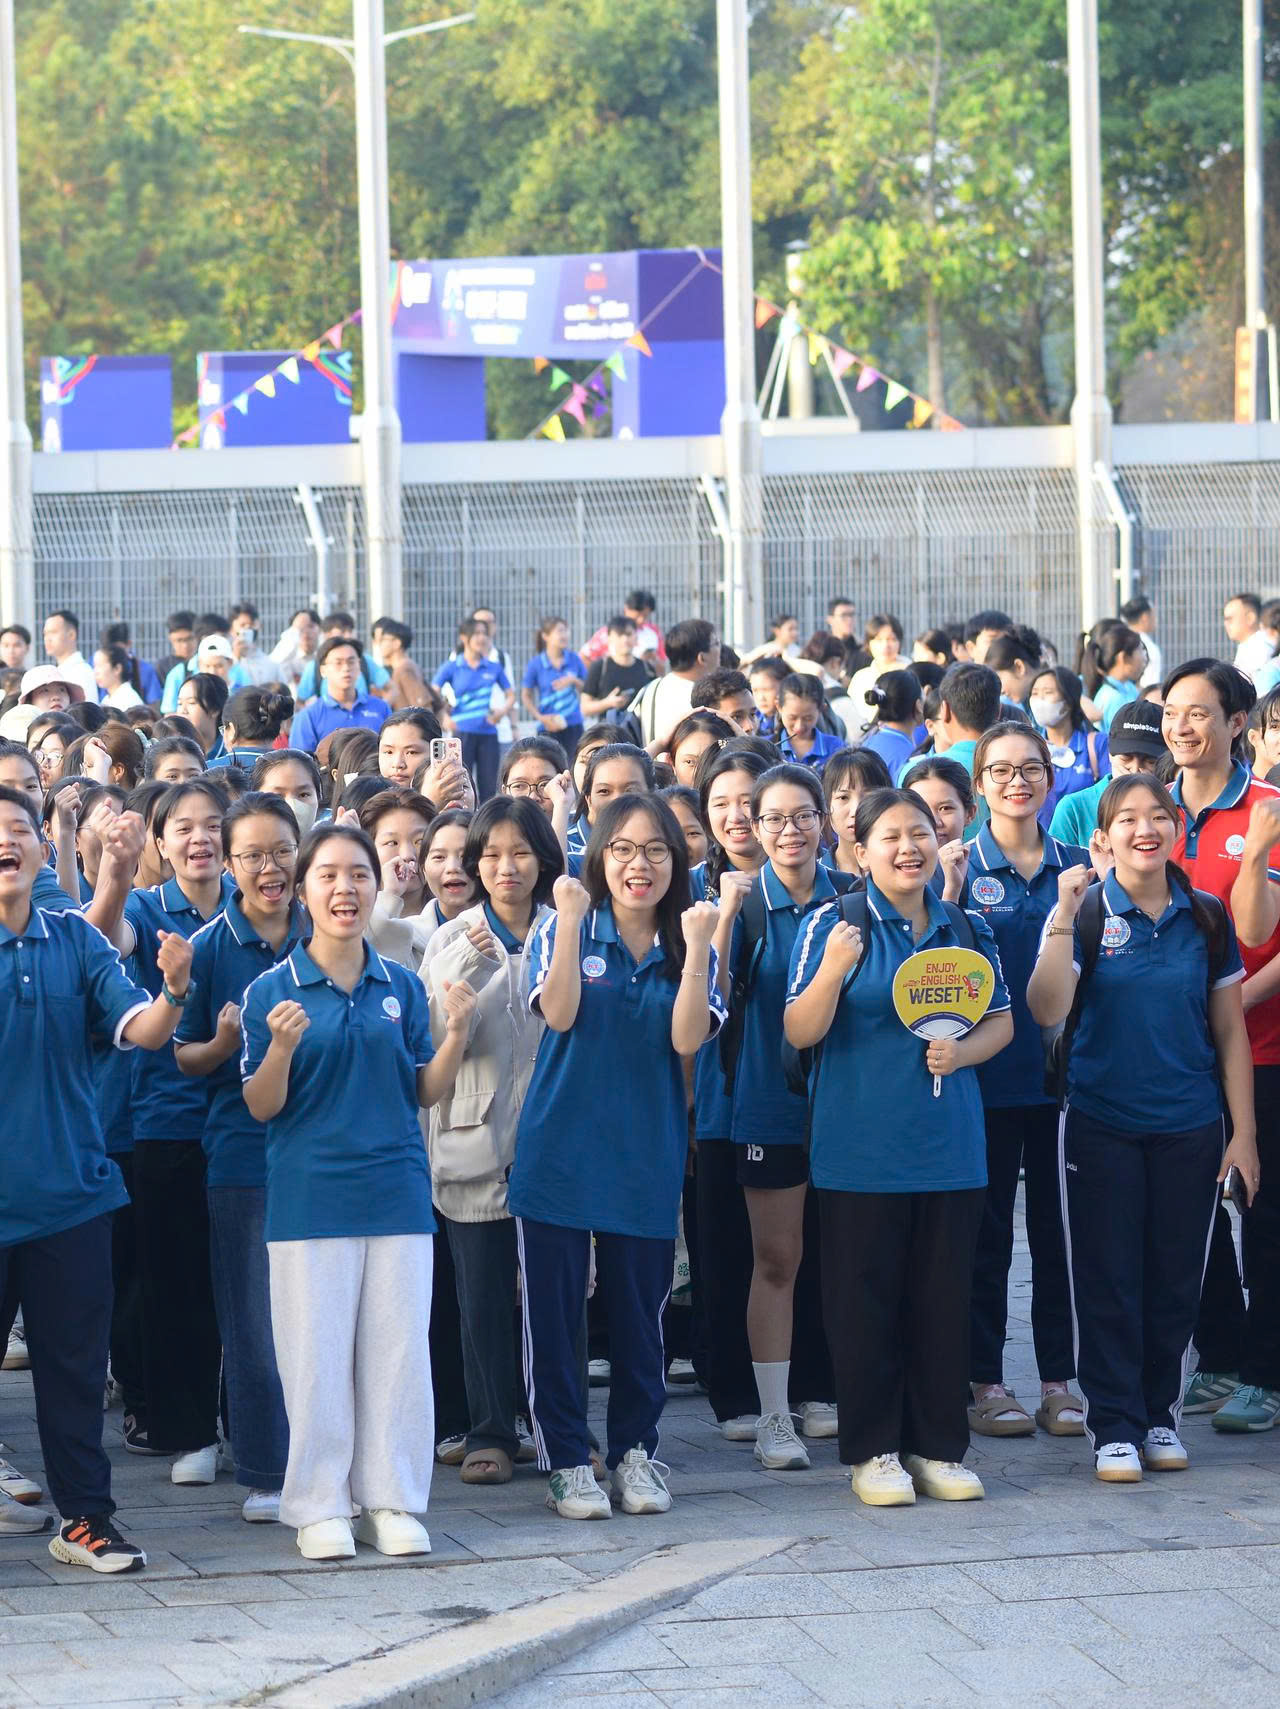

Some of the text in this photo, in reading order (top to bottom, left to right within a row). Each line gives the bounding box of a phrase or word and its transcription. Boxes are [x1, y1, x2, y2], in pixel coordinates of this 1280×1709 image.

[926, 962, 958, 974] ENJOY
[920, 974, 961, 986] ENGLISH
[909, 986, 963, 1005] WESET
